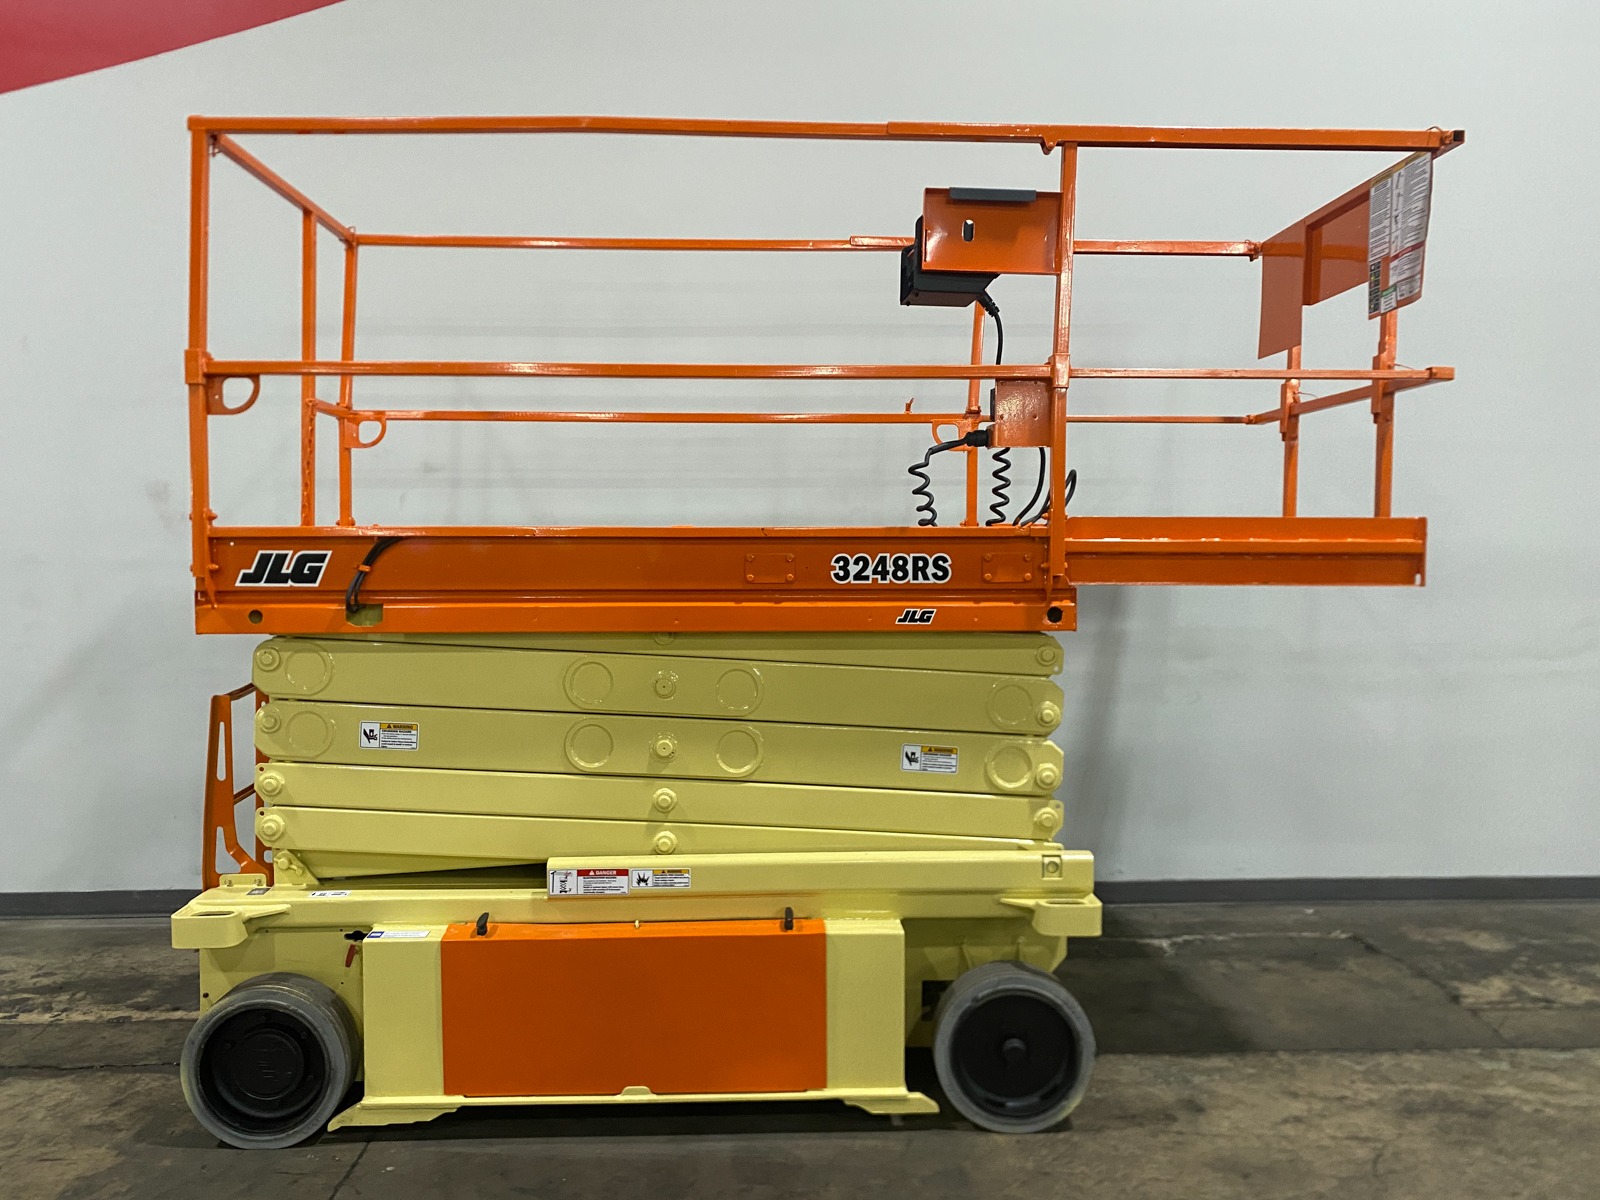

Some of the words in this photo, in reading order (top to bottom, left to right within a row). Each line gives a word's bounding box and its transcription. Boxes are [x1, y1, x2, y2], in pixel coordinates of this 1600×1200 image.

[235, 550, 333, 587] JLG
[830, 553, 952, 584] 3248RS
[895, 608, 937, 625] JLG
